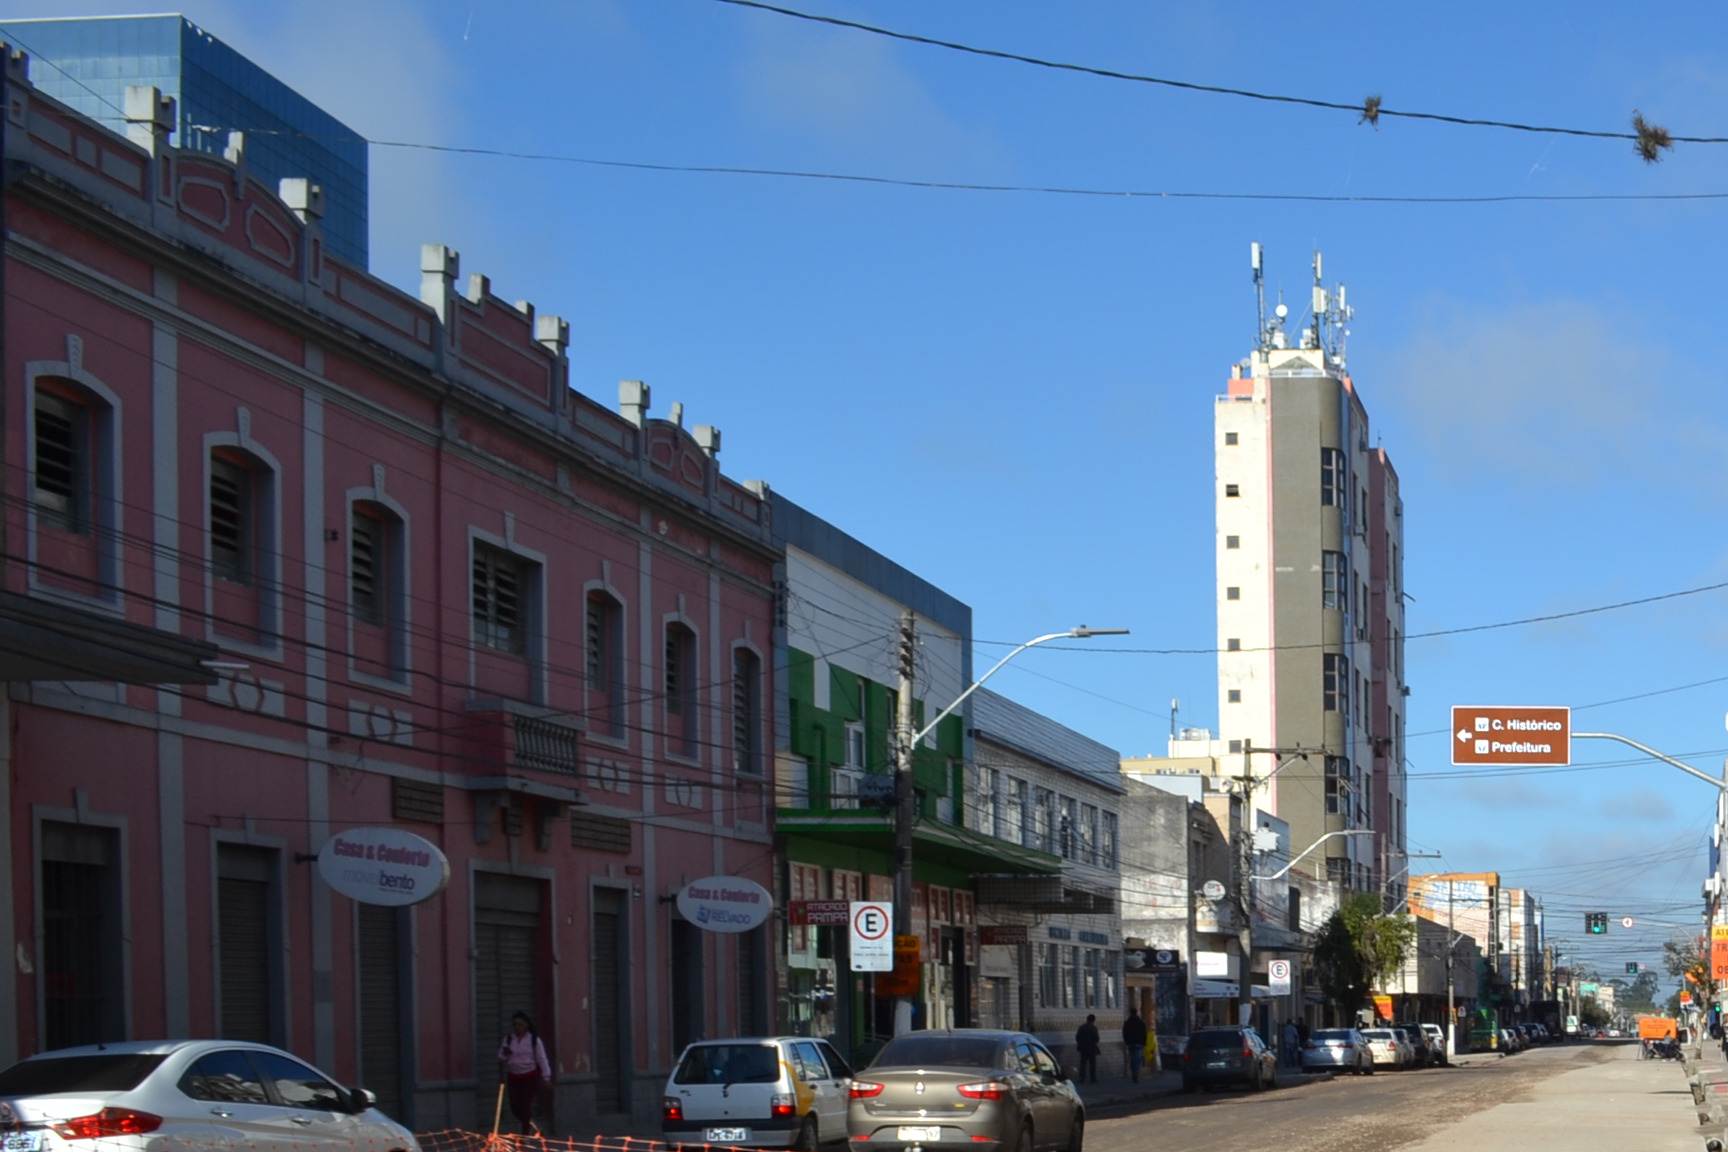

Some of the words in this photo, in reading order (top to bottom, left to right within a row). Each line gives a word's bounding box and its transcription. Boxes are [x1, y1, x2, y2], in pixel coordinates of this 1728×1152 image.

[1492, 719, 1504, 731] C.
[1507, 718, 1562, 731] Histórico
[1492, 741, 1551, 753] Prefeitura
[807, 912, 848, 924] PAMPA
[865, 913, 877, 932] E
[1276, 964, 1283, 975] E
